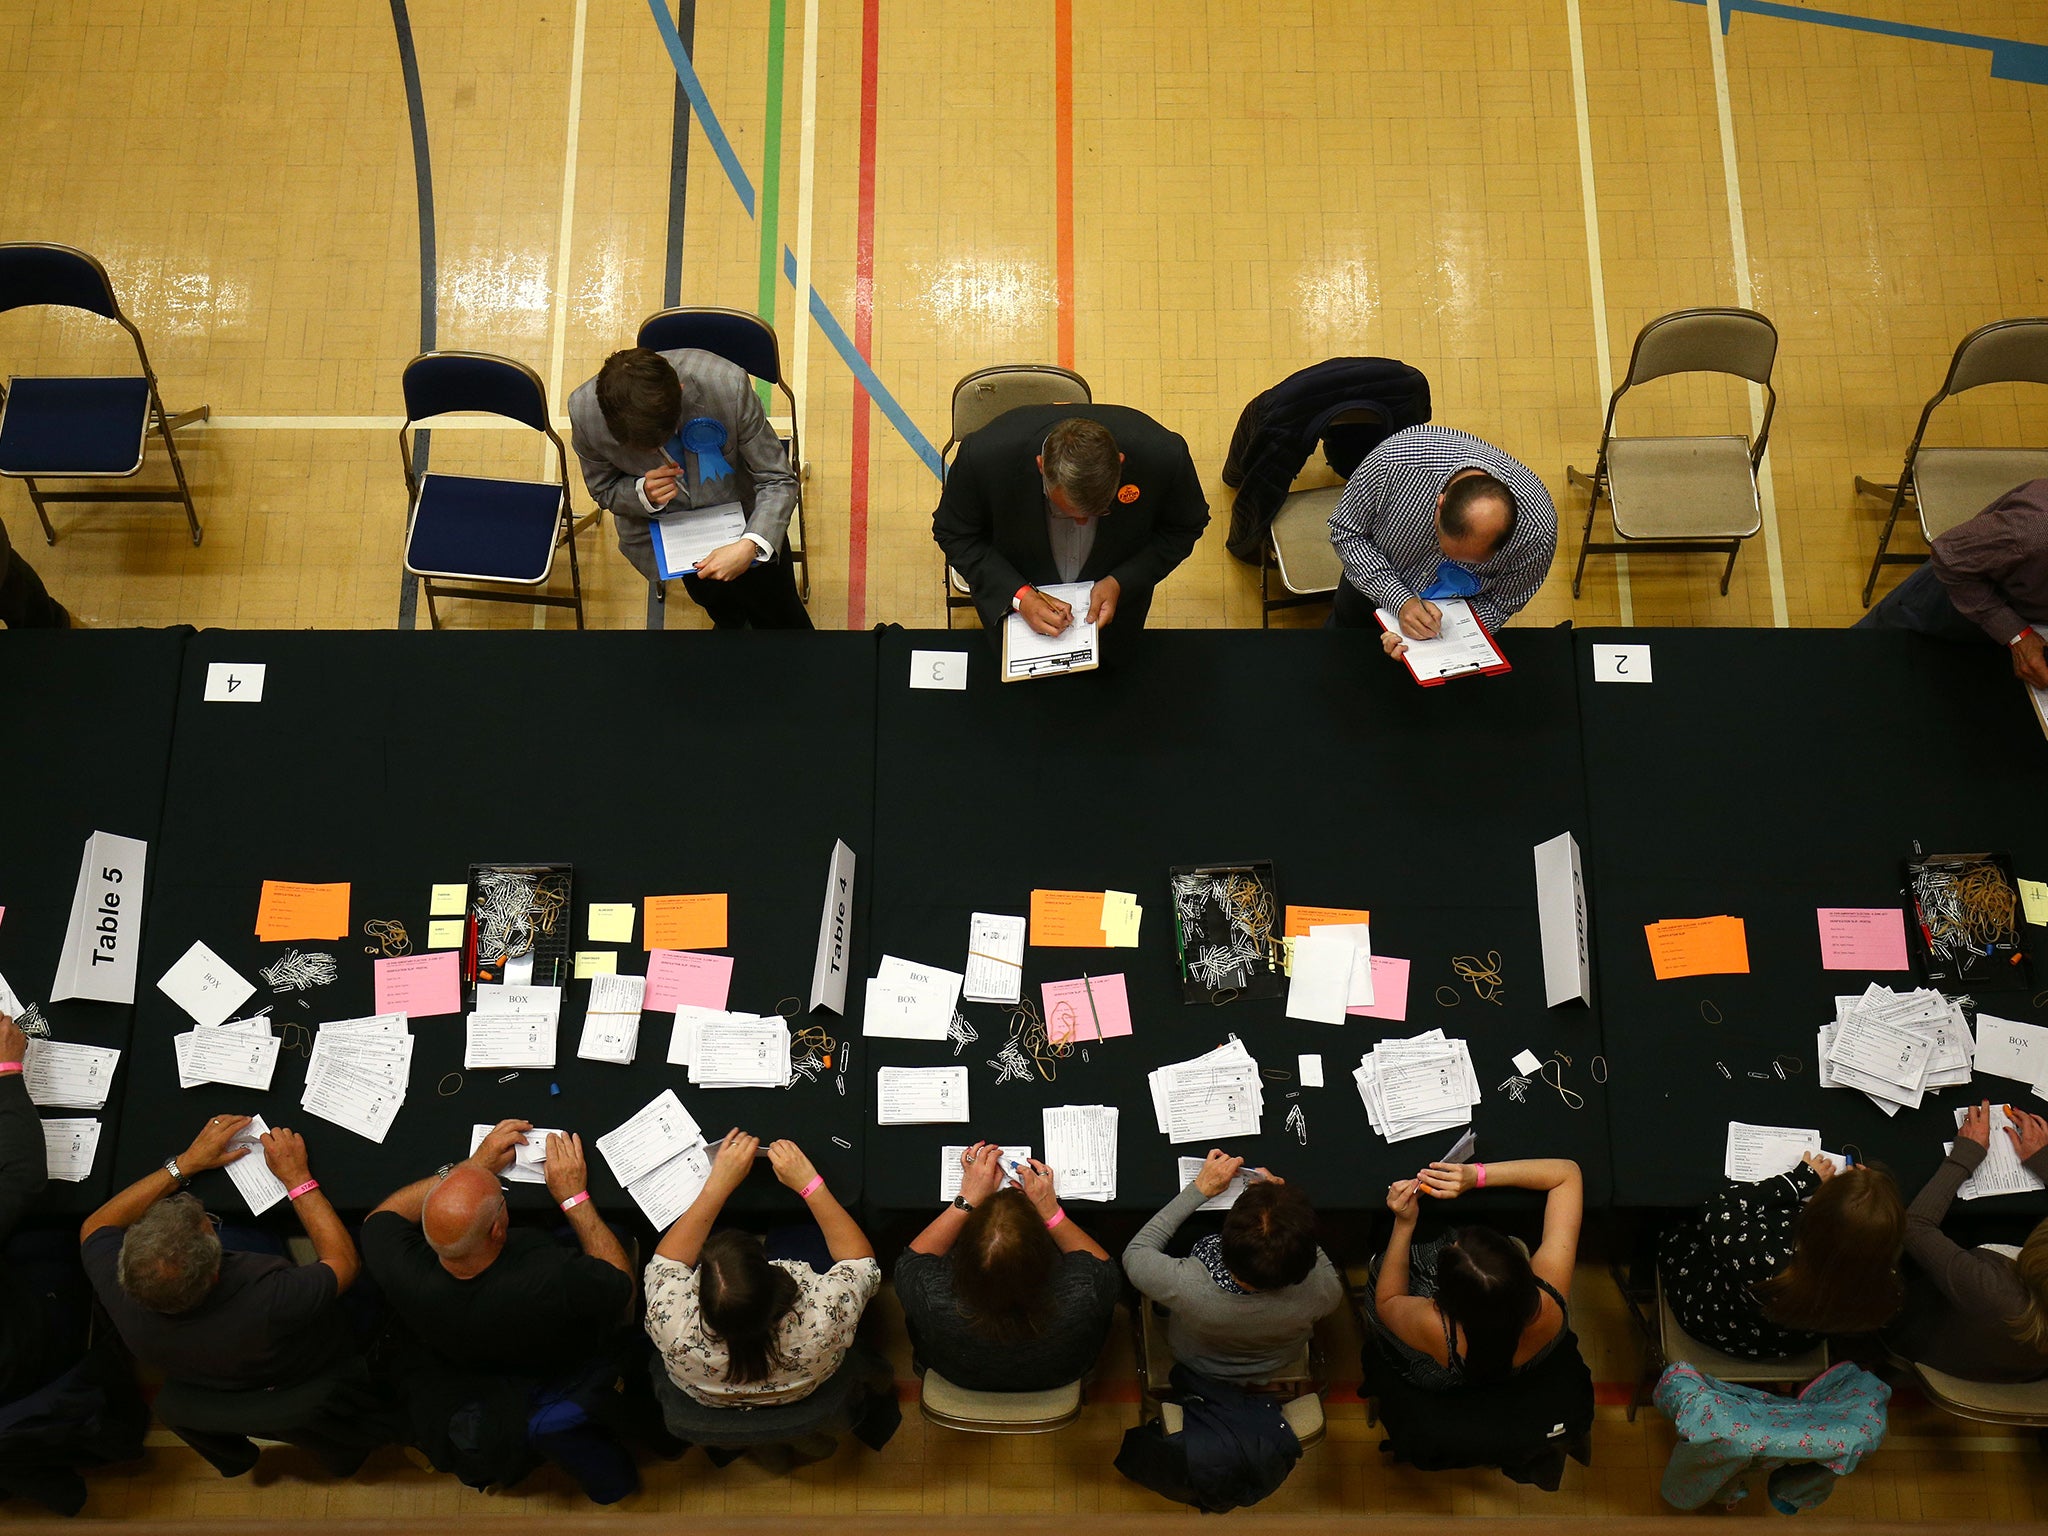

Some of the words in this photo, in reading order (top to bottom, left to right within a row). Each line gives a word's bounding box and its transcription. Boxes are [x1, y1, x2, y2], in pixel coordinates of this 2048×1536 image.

[932, 661, 945, 681] 3
[1614, 654, 1629, 675] 2
[227, 673, 242, 693] 4
[102, 867, 123, 884] 5
[91, 892, 120, 967] Table
[830, 902, 846, 975] Table
[839, 877, 848, 894] 4
[1575, 894, 1586, 967] Table
[203, 972, 222, 989] BOX
[910, 972, 930, 984] BOX
[508, 995, 528, 1004] BOX
[897, 995, 917, 1004] BOX
[2008, 1036, 2029, 1048] BOX
[2015, 1048, 2021, 1056] 7
